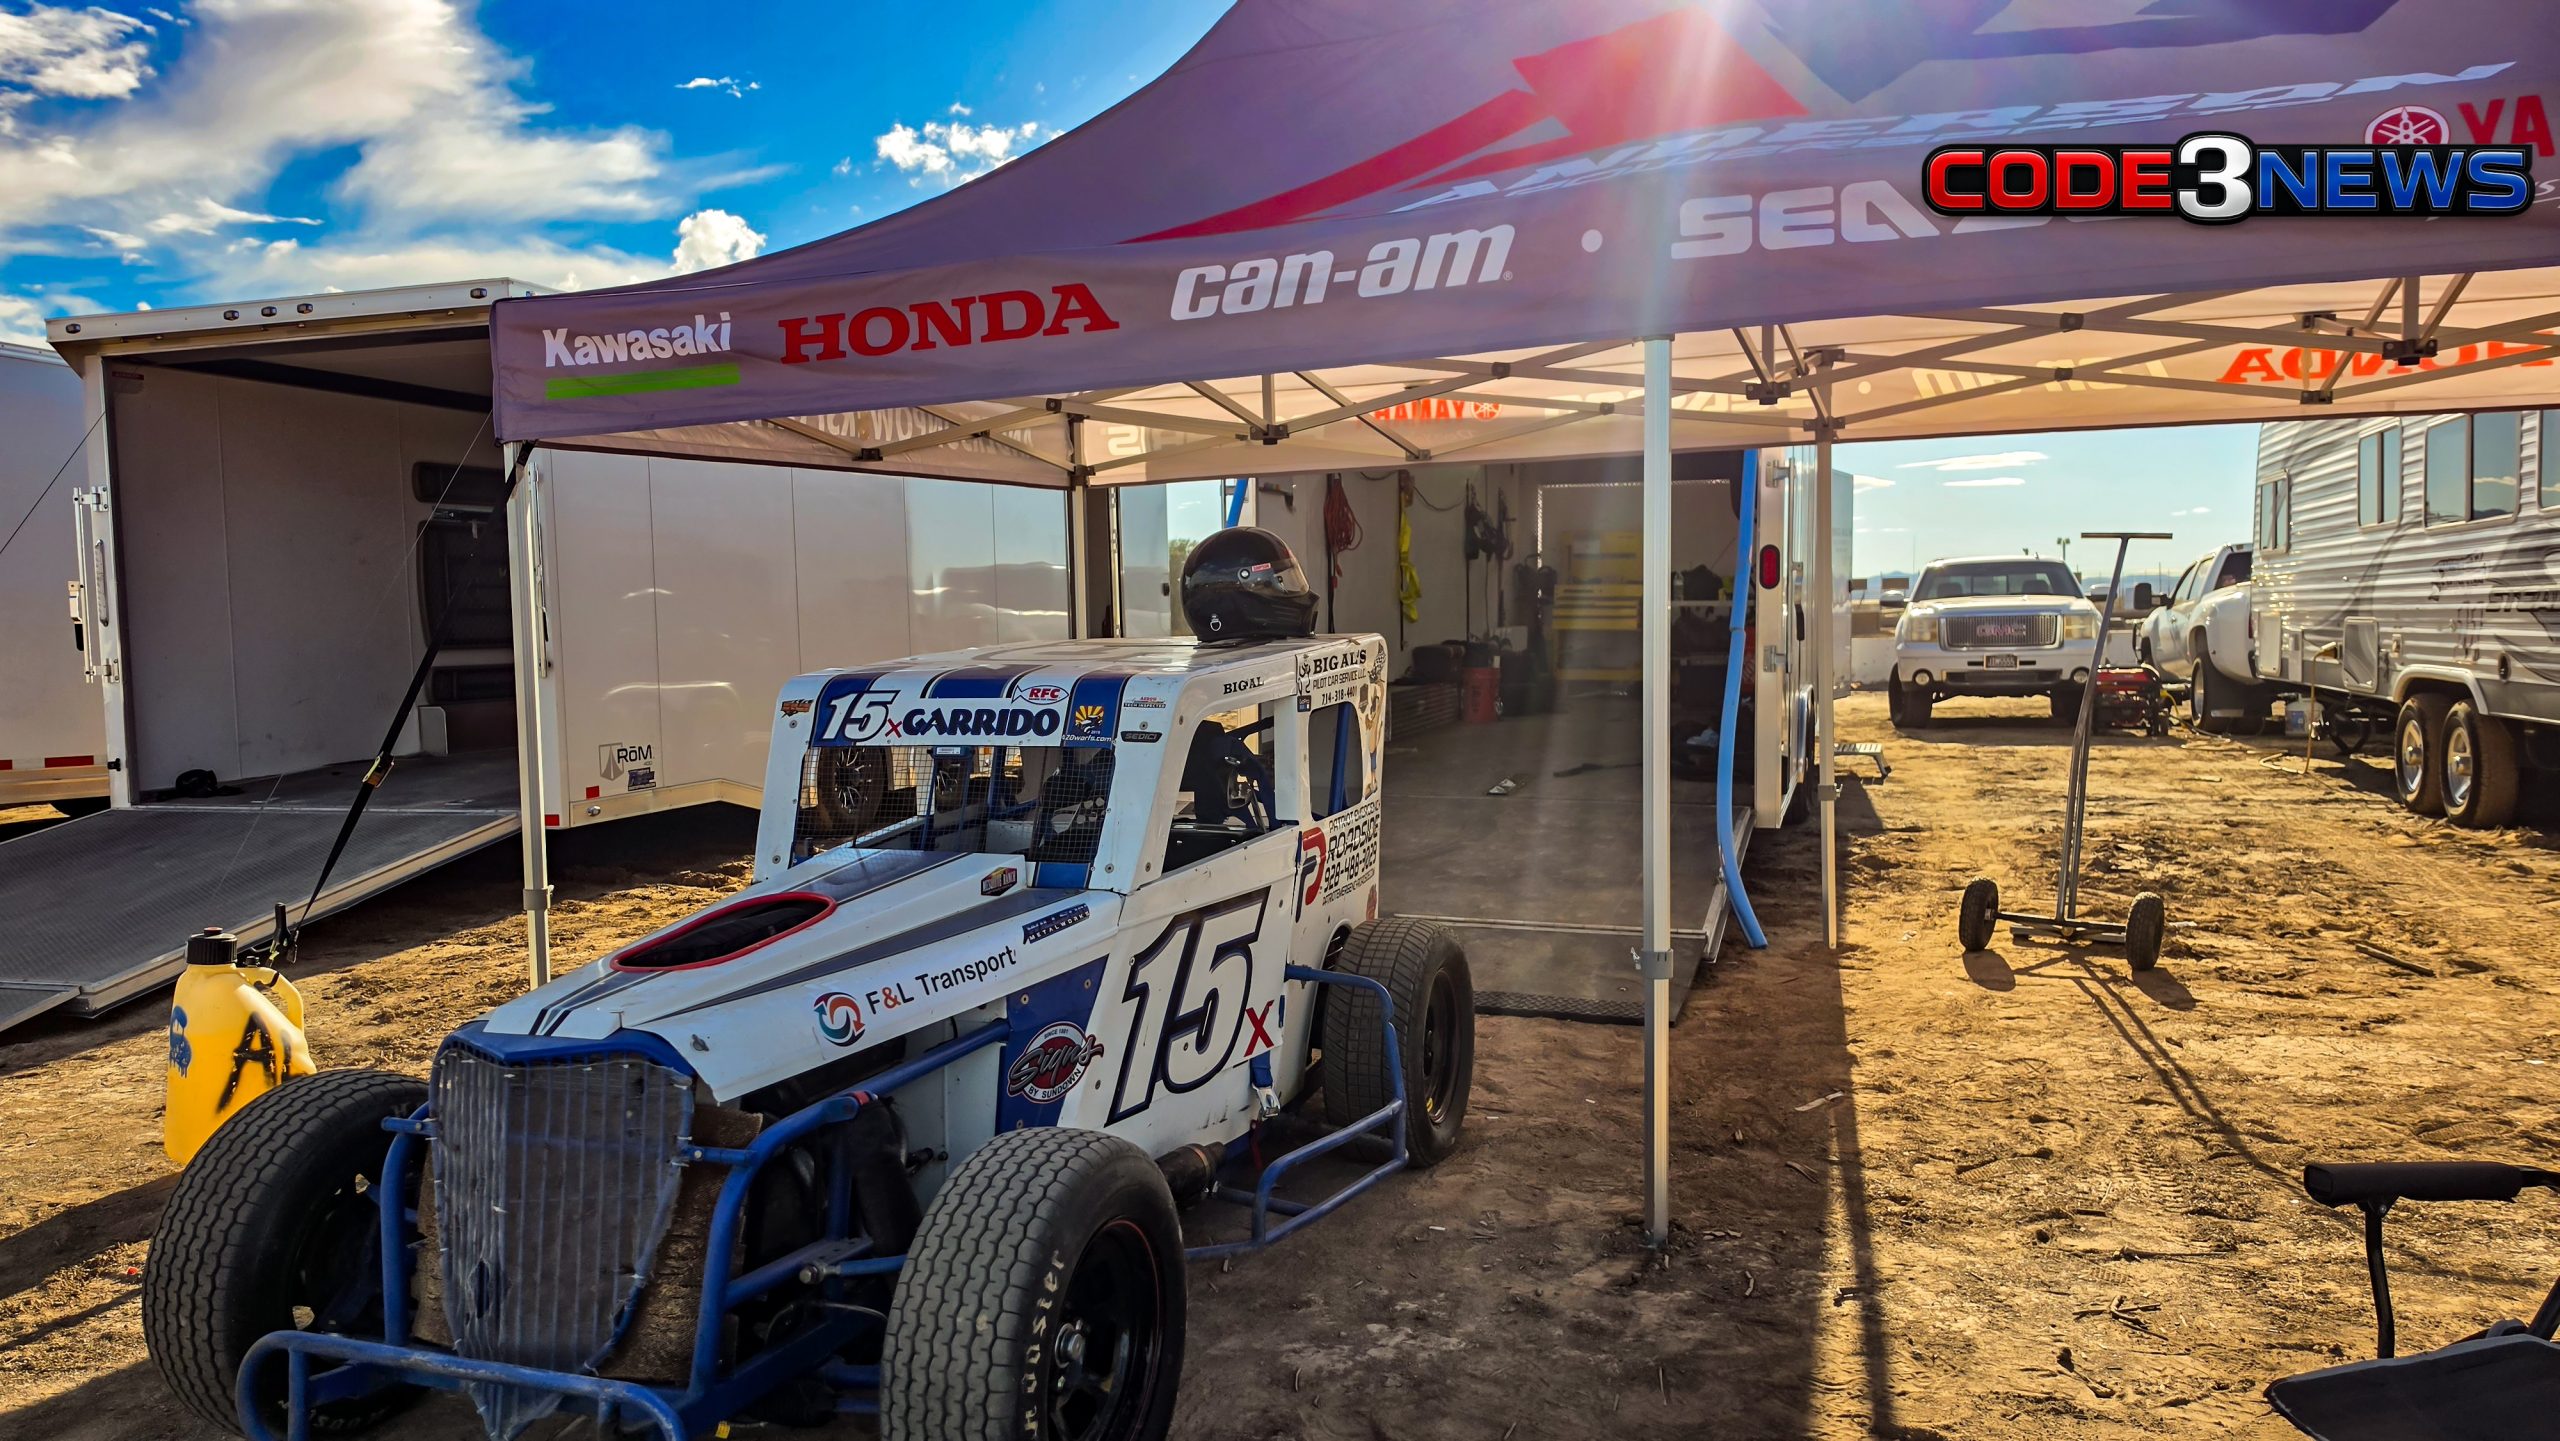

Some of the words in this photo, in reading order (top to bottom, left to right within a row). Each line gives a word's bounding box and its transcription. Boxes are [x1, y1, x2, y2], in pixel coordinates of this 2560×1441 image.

[777, 282, 1120, 365] HONDA
[542, 311, 732, 369] Kawasaki
[1977, 624, 2026, 637] GMC
[1313, 655, 1338, 674] BIG
[1340, 649, 1367, 669] AL'S
[1028, 688, 1061, 699] RFC
[1223, 681, 1248, 695] BIG
[1313, 677, 1327, 690] PILOT
[1328, 675, 1339, 687] CAR
[1339, 669, 1358, 684] SERVICE
[820, 689, 900, 742] 15
[902, 708, 1061, 737] GARRIDO
[1125, 732, 1157, 741] SEDICI
[1327, 814, 1380, 863] ROADSIDE
[1029, 911, 1090, 941] METALWORKS
[866, 982, 914, 1015] F&L
[915, 946, 1016, 997] Transport
[1104, 886, 1271, 1127] 15
[1008, 1035, 1104, 1092] Signs
[1028, 1085, 1039, 1096] BY
[1041, 1068, 1082, 1099] SUNDOWN
